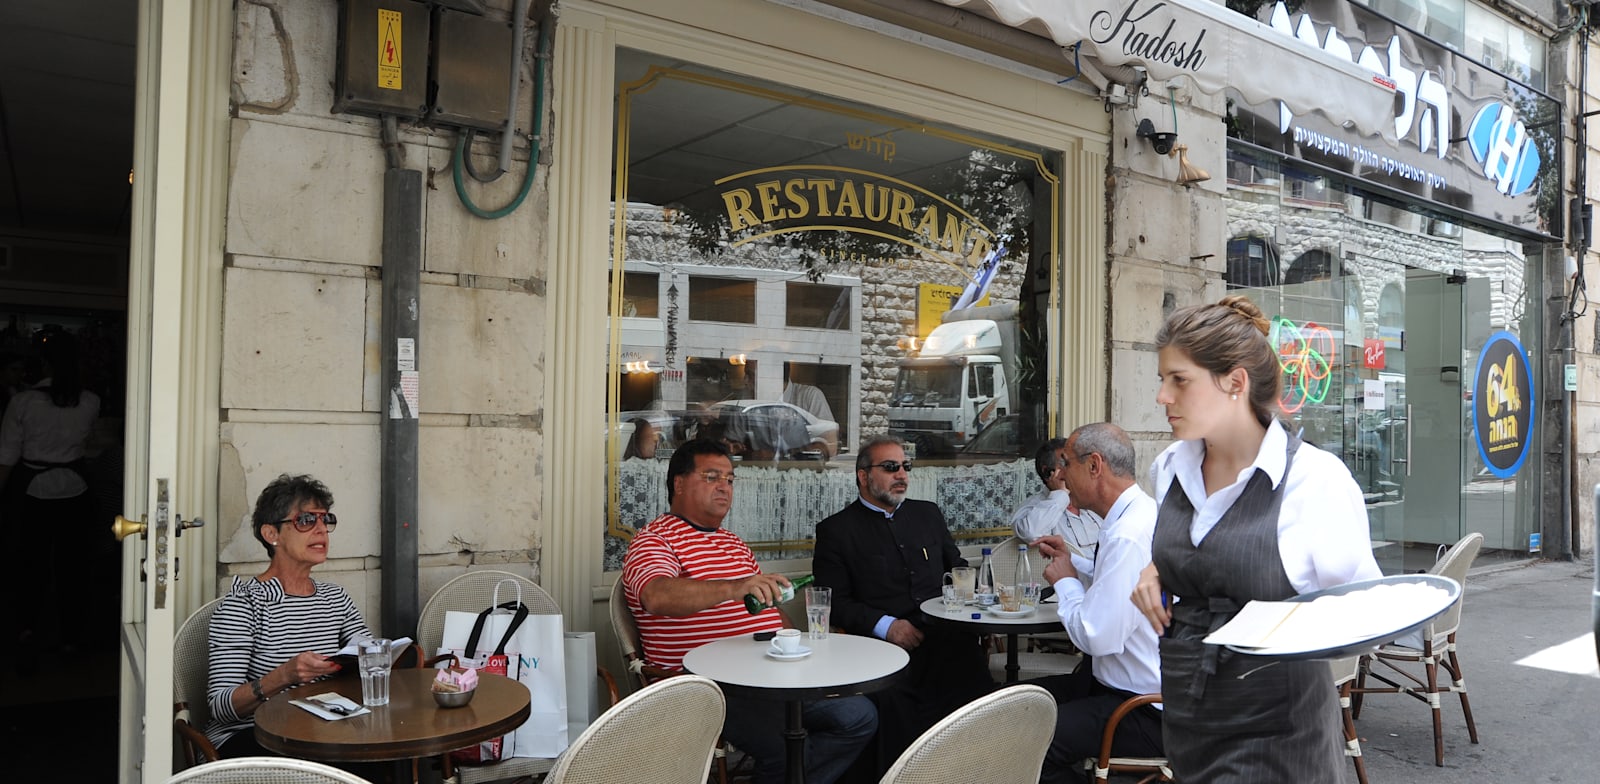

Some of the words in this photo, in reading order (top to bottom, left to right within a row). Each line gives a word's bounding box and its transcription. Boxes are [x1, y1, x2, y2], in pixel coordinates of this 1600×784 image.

[1089, 0, 1207, 72] Kadosh
[1294, 126, 1350, 159] והמקצועית
[1352, 144, 1379, 168] הזולה
[1381, 157, 1426, 183] האופטיקה
[1427, 172, 1447, 191] רשת
[720, 178, 993, 269] RESTAURANT
[819, 247, 868, 263] SINCE
[1489, 414, 1519, 443] הנחה
